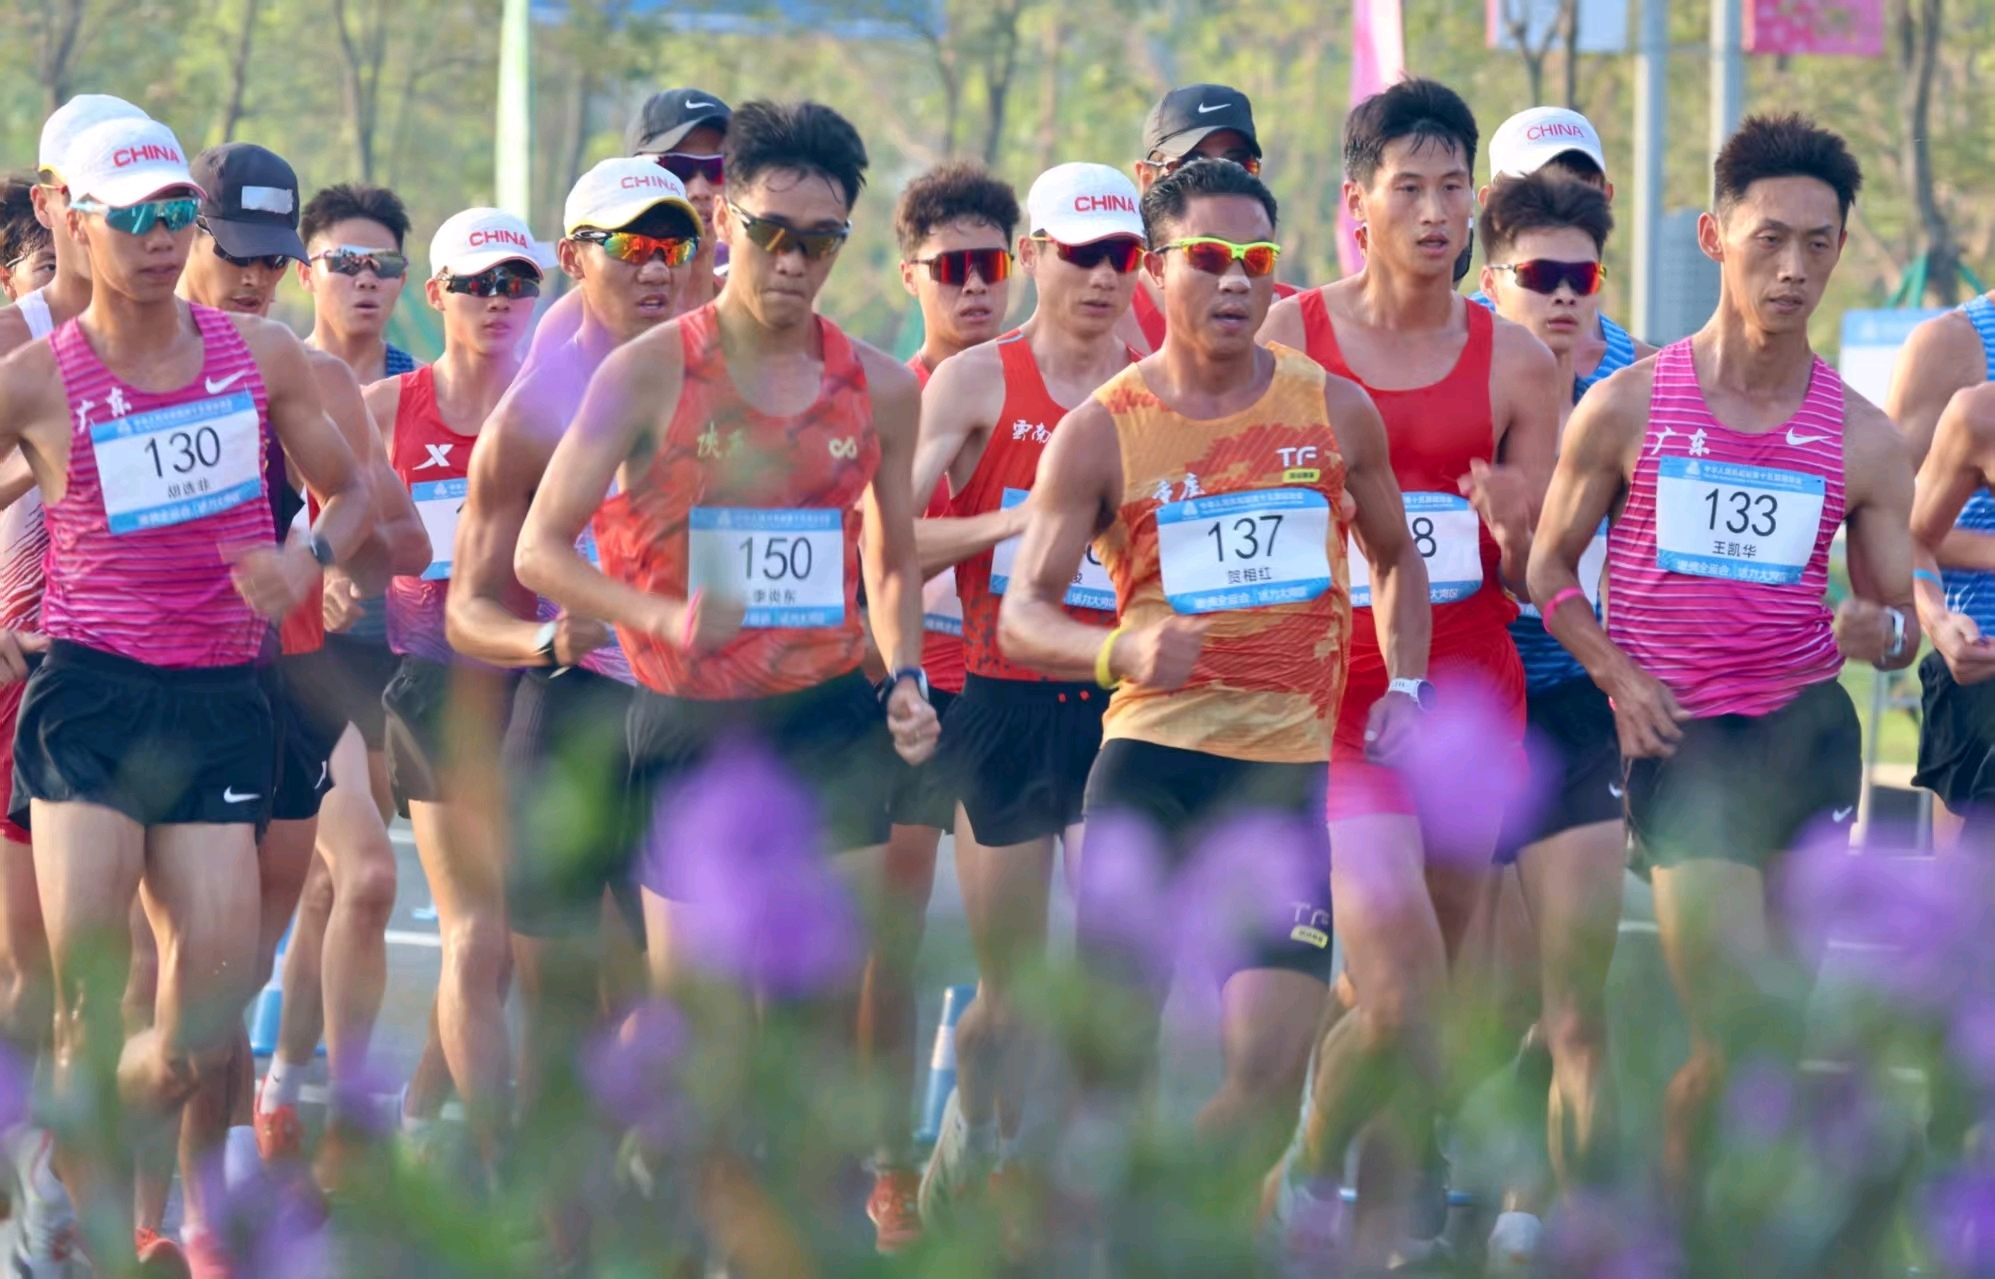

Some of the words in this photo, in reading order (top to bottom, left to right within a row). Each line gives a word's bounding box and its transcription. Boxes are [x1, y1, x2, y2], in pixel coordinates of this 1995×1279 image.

[1526, 123, 1584, 141] CHINA
[112, 144, 180, 168] CHINA
[620, 175, 681, 197] CHINA
[1074, 194, 1136, 214] CHINA
[469, 229, 529, 249] CHINA
[144, 426, 221, 478] 130
[1705, 487, 1779, 537] 133
[1207, 514, 1284, 562] 137
[1711, 540, 1757, 559] 王凯华
[739, 536, 812, 580] 150
